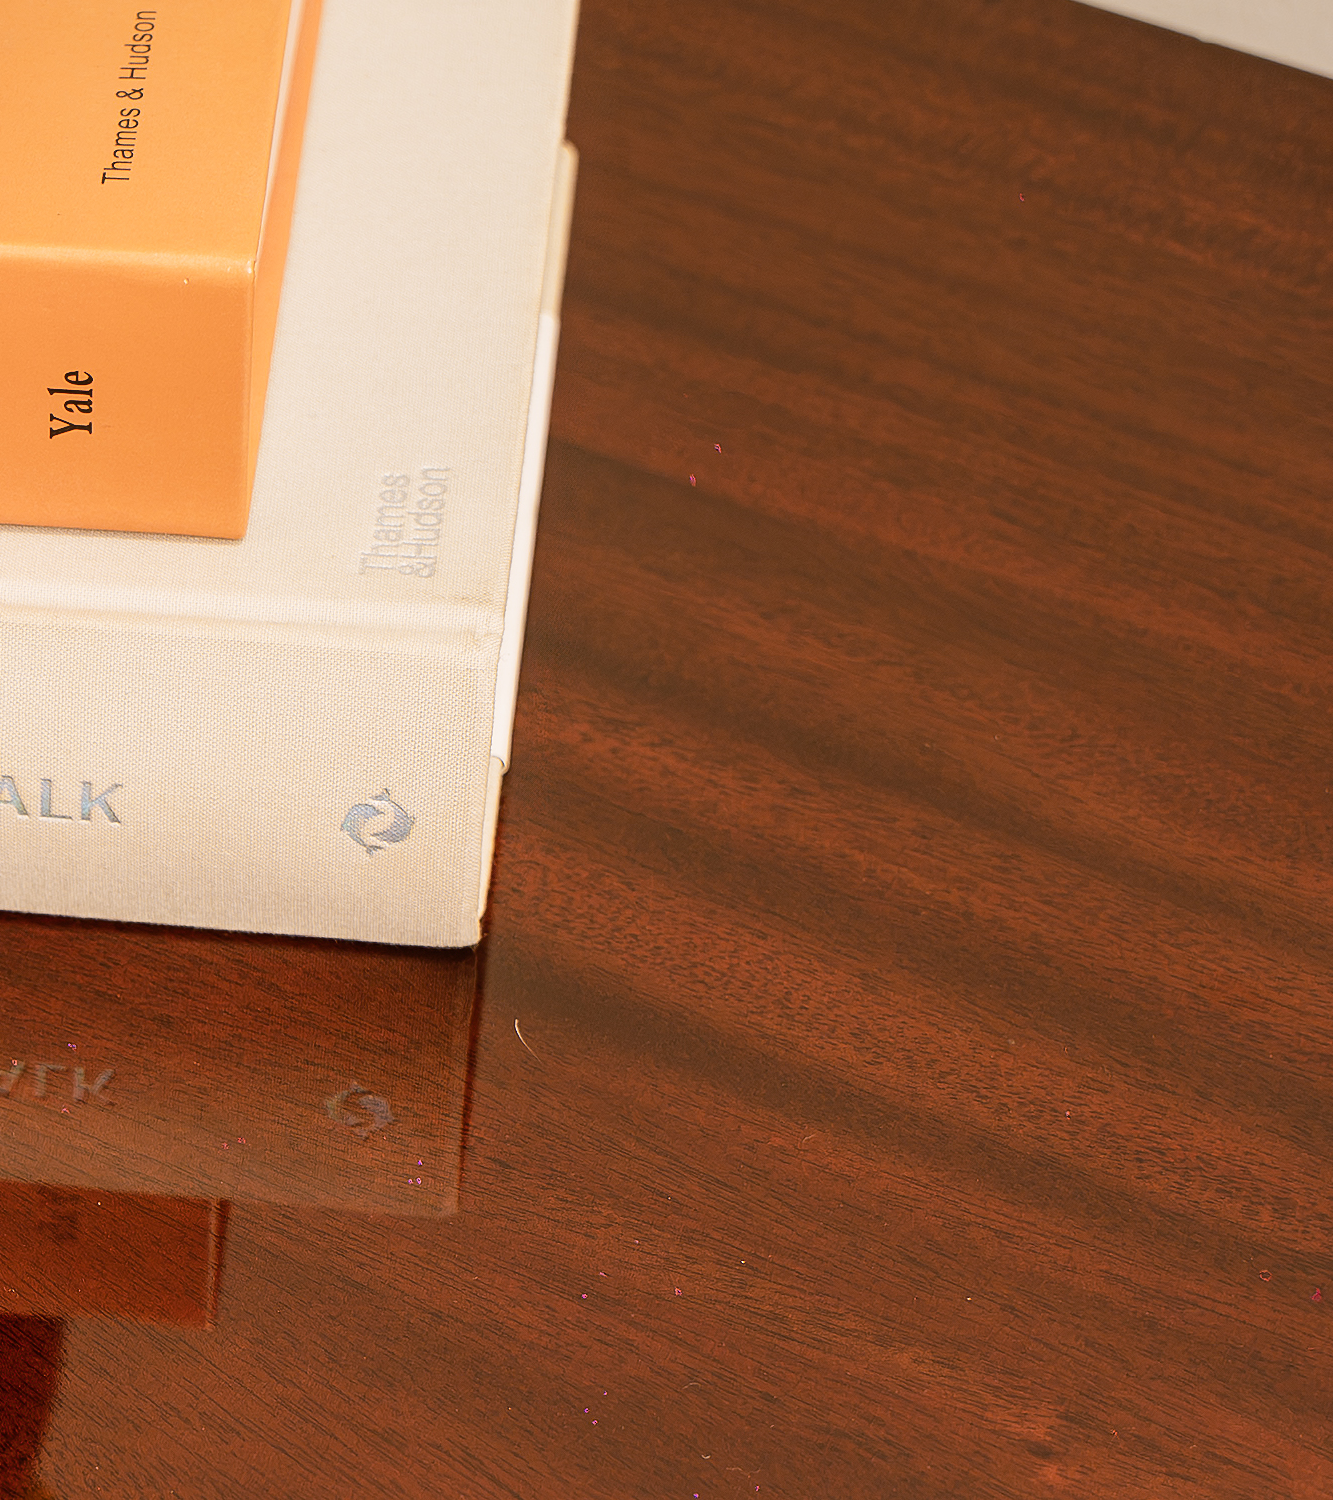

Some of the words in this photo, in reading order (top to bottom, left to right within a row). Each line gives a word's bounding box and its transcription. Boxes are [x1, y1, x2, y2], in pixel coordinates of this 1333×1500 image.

[118, 10, 157, 80] Hudson
[115, 87, 144, 101] &
[101, 108, 141, 184] Thames
[46, 369, 94, 440] Yale
[357, 473, 411, 576] Thames
